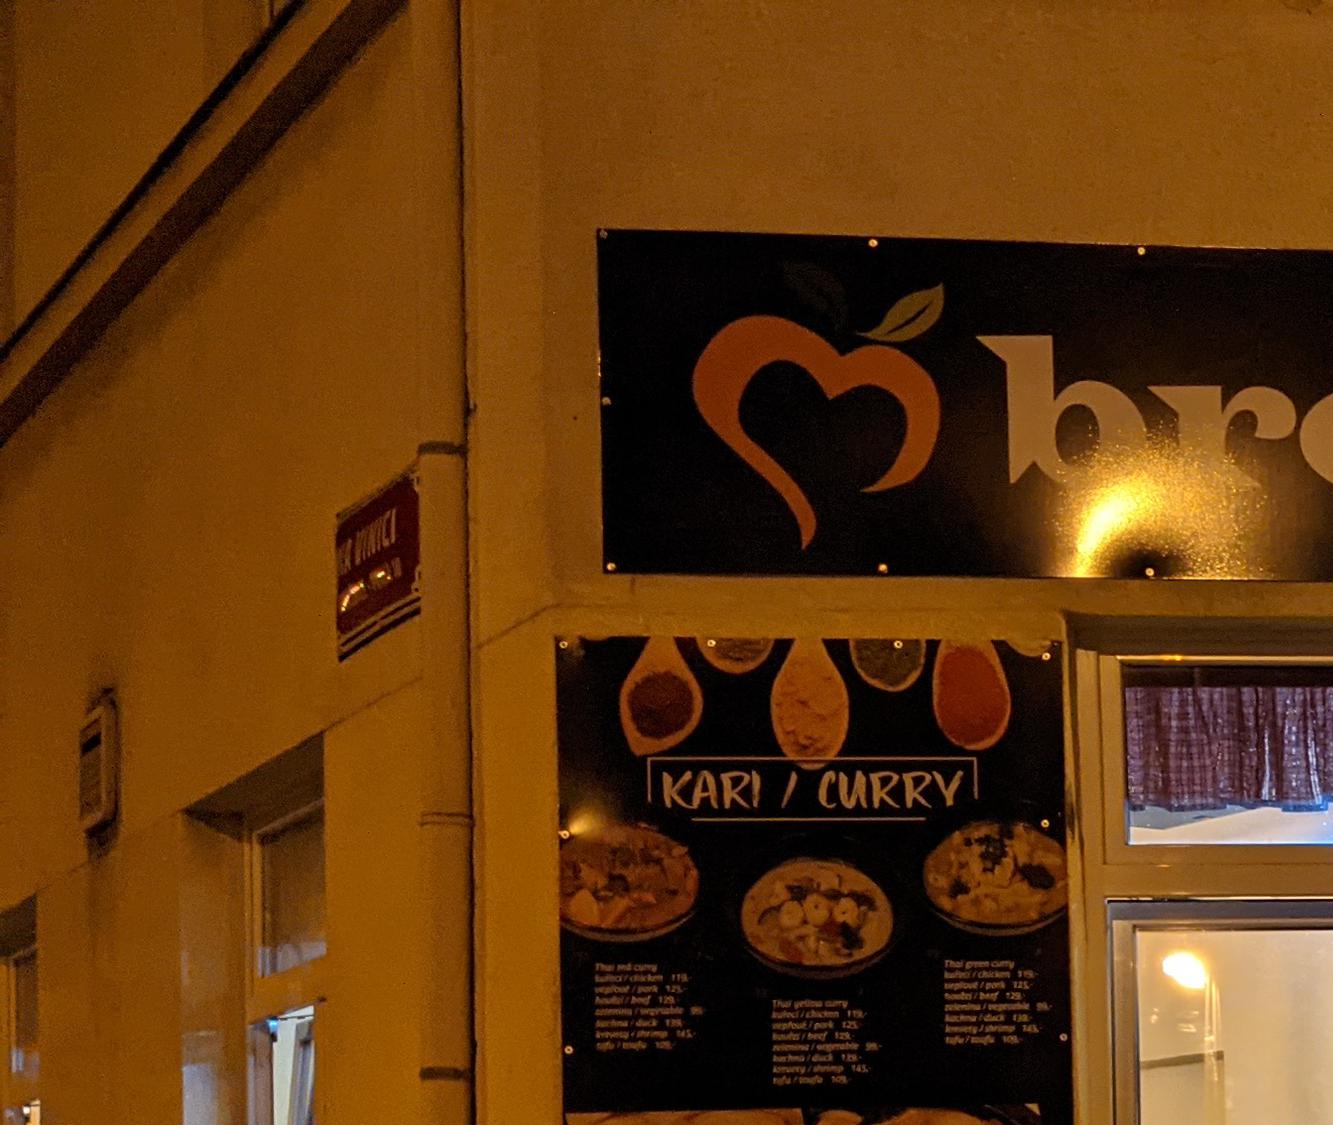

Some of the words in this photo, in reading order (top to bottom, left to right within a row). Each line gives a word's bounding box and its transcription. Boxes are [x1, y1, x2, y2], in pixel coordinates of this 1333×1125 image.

[662, 769, 762, 810] KARI
[780, 772, 800, 809] /
[818, 769, 965, 810] CURRY
